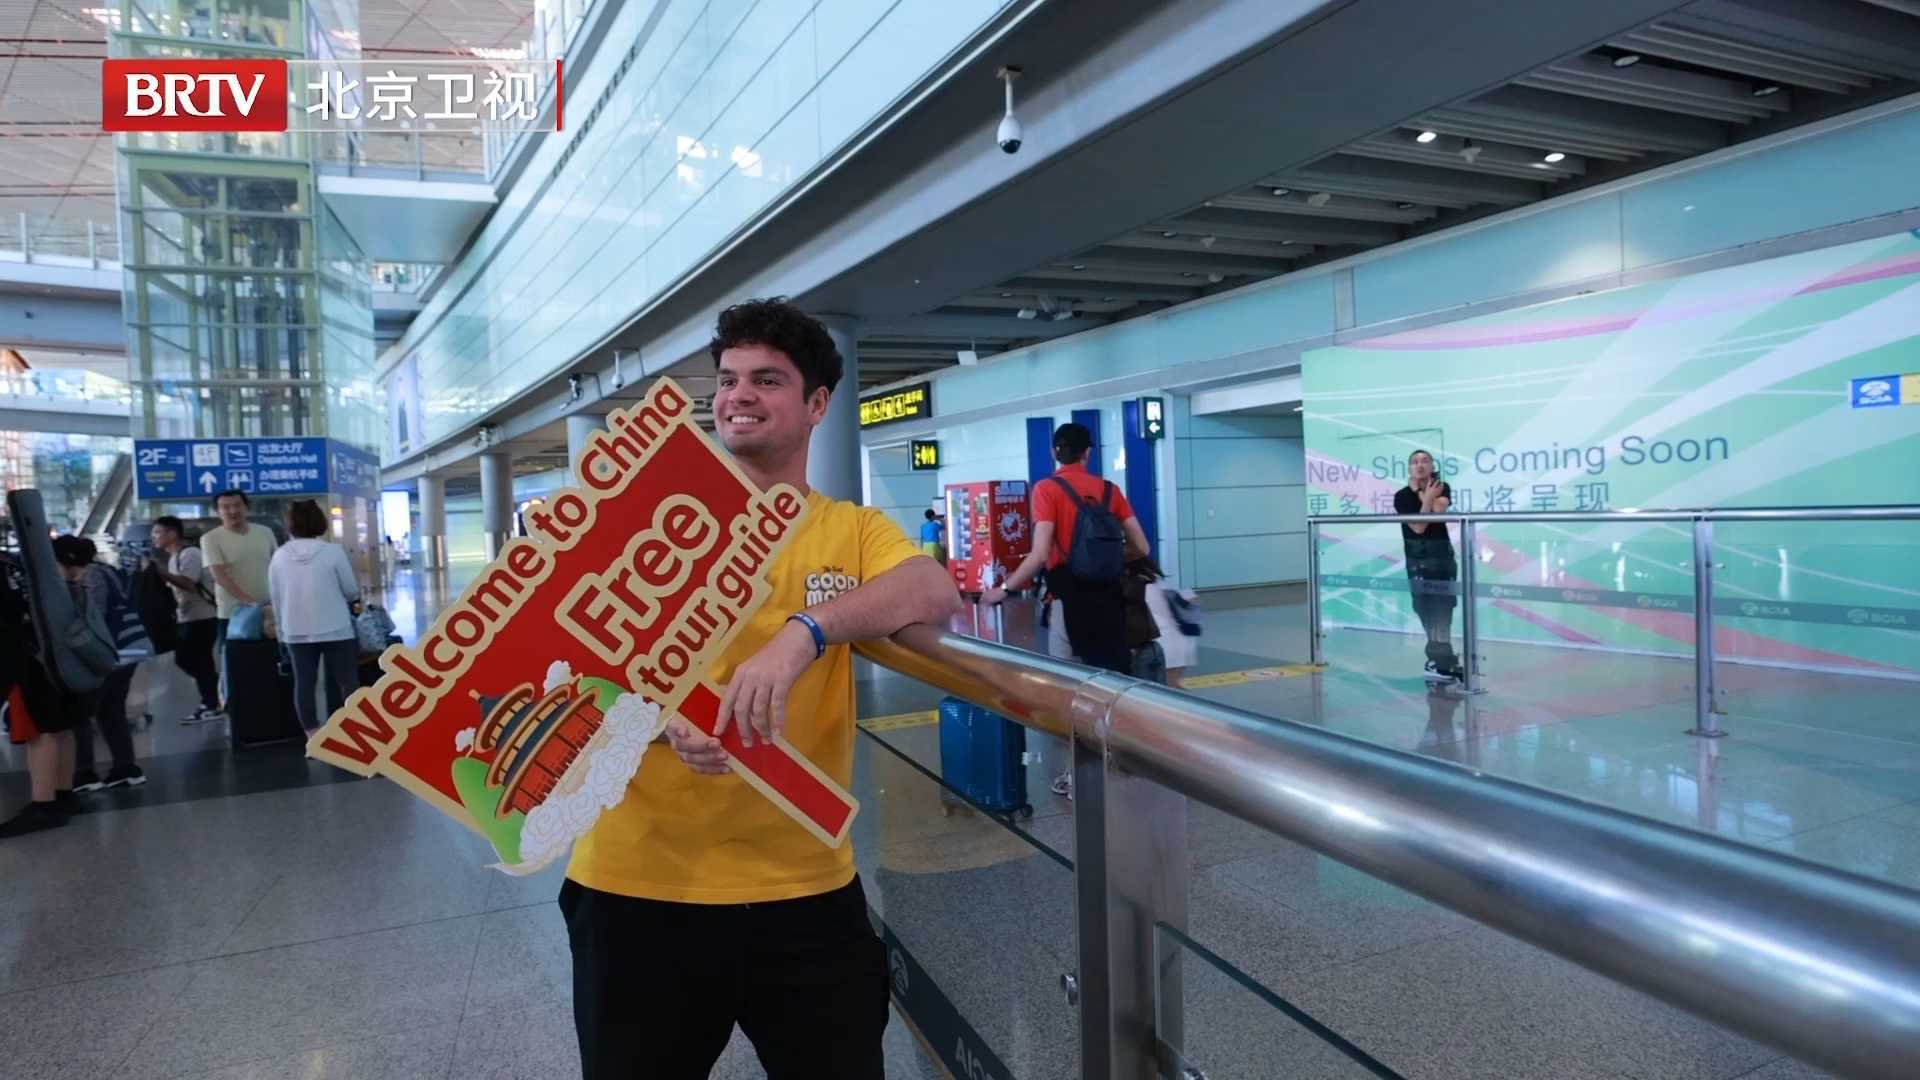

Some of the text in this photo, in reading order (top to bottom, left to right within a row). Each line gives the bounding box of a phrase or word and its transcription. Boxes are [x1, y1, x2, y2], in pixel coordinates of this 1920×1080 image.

[139, 448, 168, 466] 2F
[257, 454, 300, 465] Departure
[1308, 435, 1730, 484] New Shs Coming Soon
[259, 481, 303, 492] Check-in
[1309, 482, 1610, 517] 更多惊即将呈现
[320, 540, 546, 766] Welcome
[531, 494, 588, 543] to
[581, 384, 687, 490] China
[566, 504, 711, 654] Free
[806, 573, 858, 592] GOOD
[637, 492, 802, 695] tour guide
[1759, 605, 1792, 616] BCIA
